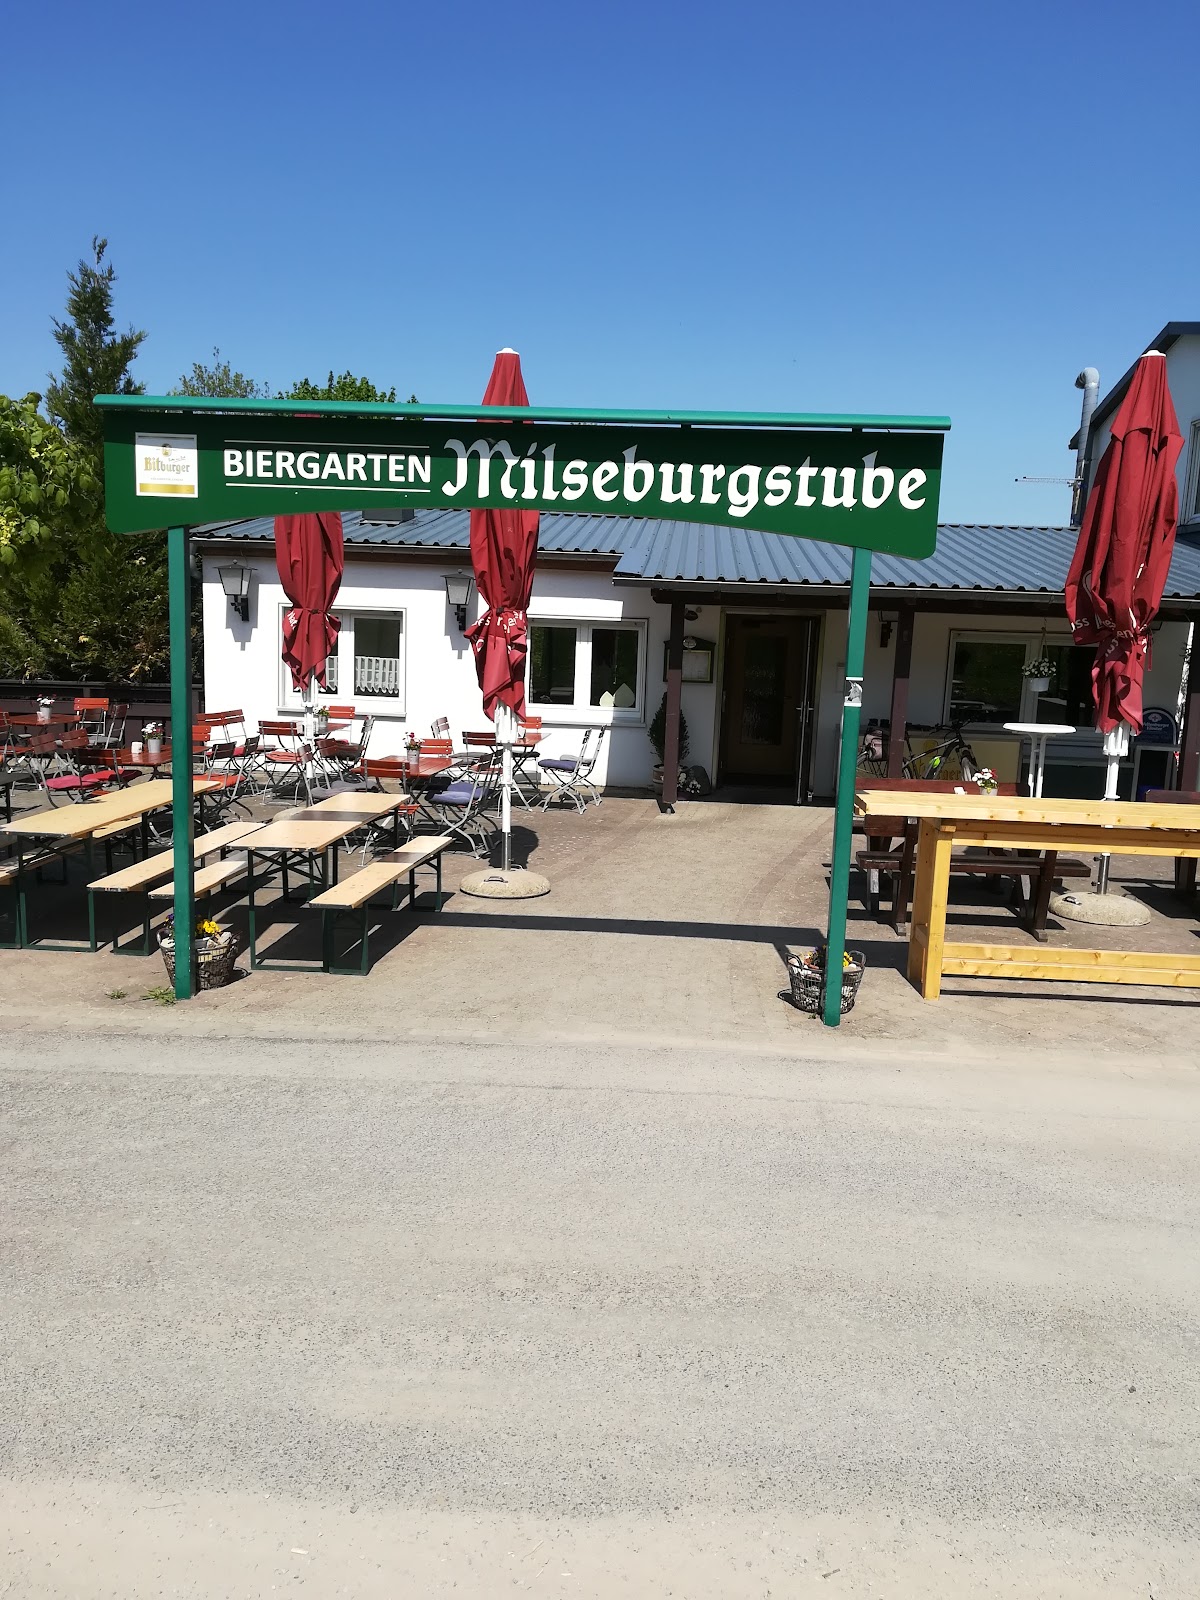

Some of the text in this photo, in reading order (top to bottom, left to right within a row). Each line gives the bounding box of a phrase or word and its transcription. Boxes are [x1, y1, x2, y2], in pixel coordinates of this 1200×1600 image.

[144, 456, 191, 474] Bitburger
[223, 438, 928, 518] BIERGARTEN Milseburgstube
